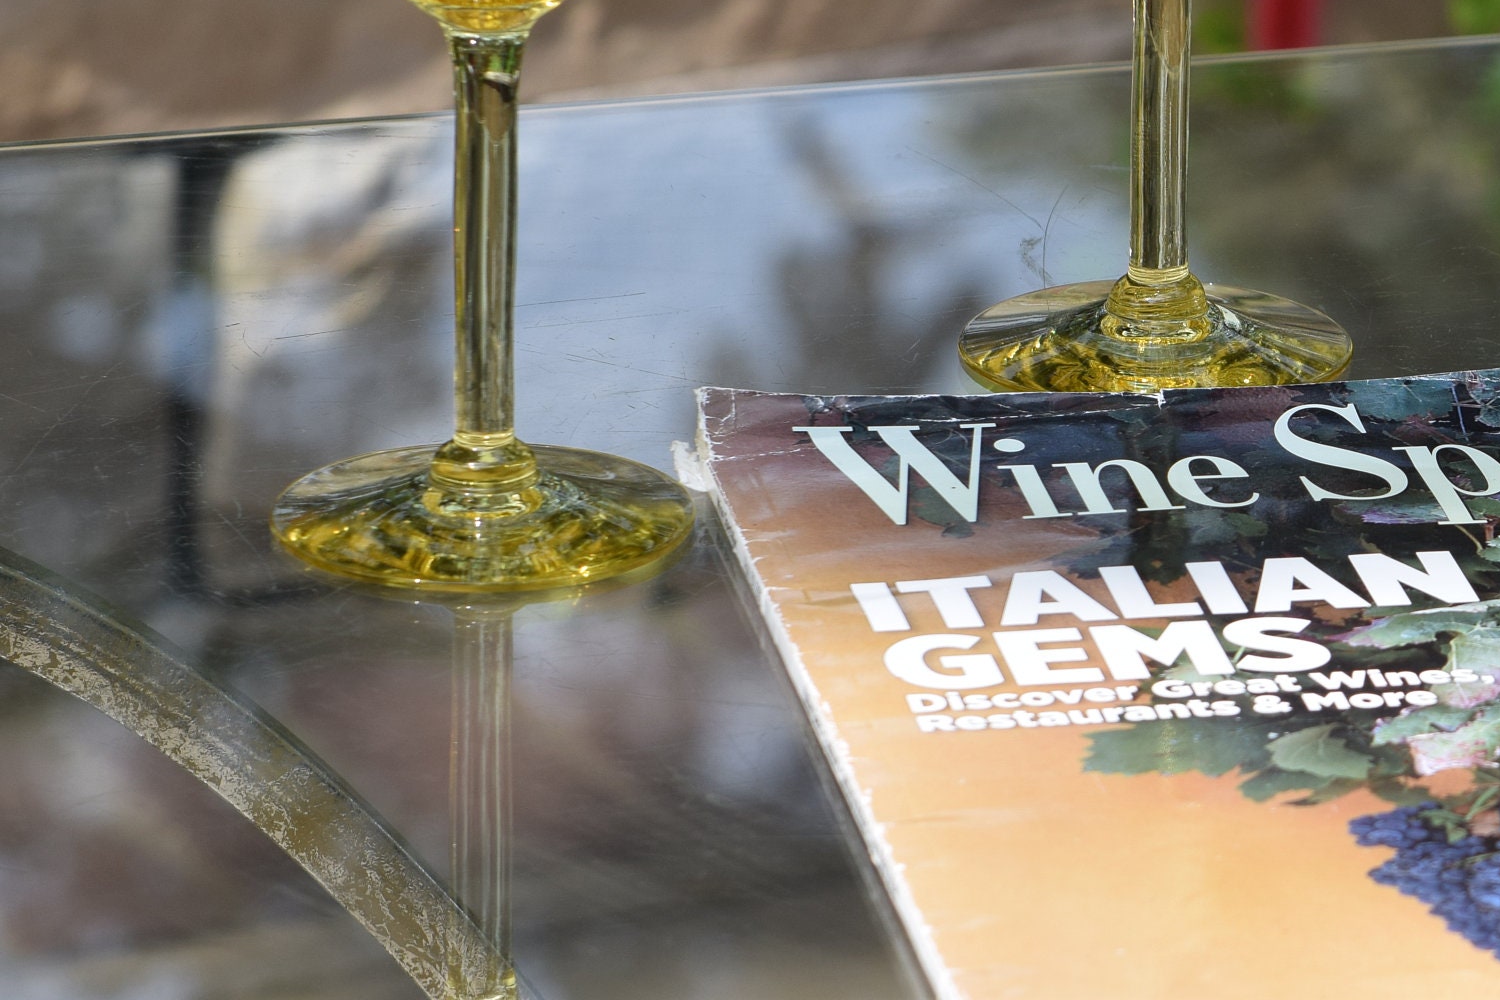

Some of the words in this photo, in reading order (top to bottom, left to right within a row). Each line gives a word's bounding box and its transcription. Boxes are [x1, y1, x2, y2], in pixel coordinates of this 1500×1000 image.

[793, 422, 1260, 526] Wine
[850, 550, 1481, 632] ITALIAN
[883, 616, 1332, 690] GEMS
[905, 684, 1138, 714] Discover
[1151, 673, 1302, 699] Great
[1308, 668, 1496, 690] Wines,
[915, 698, 1242, 733] Restaurants
[1252, 694, 1294, 715] &
[1301, 689, 1438, 712] More
